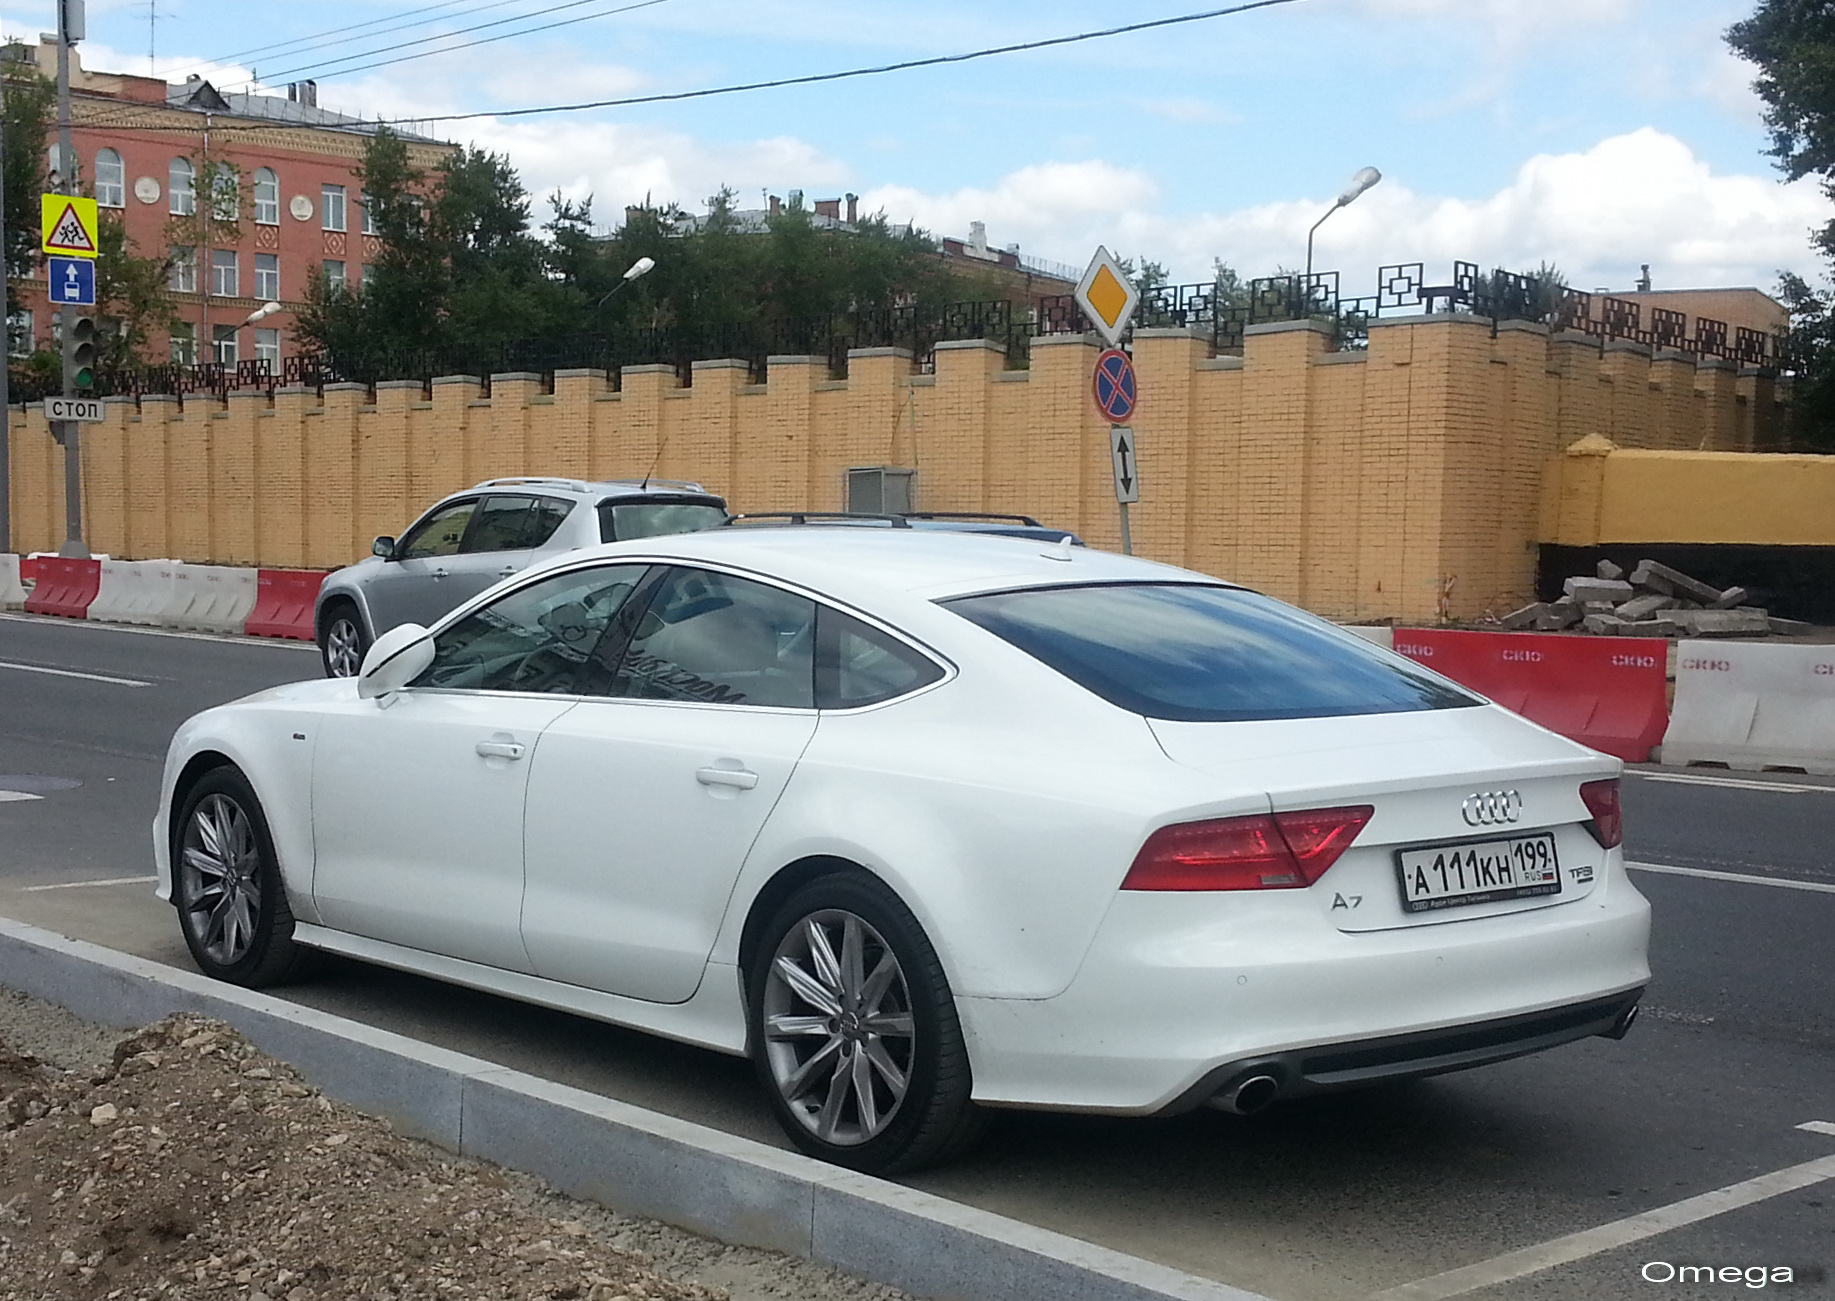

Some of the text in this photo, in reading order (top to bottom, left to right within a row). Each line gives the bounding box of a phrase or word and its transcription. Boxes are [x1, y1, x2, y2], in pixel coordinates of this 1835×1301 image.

[52, 401, 98, 418] СТОП
[1514, 840, 1548, 871] 199
[1524, 869, 1542, 882] RUS
[1330, 892, 1363, 911] A7
